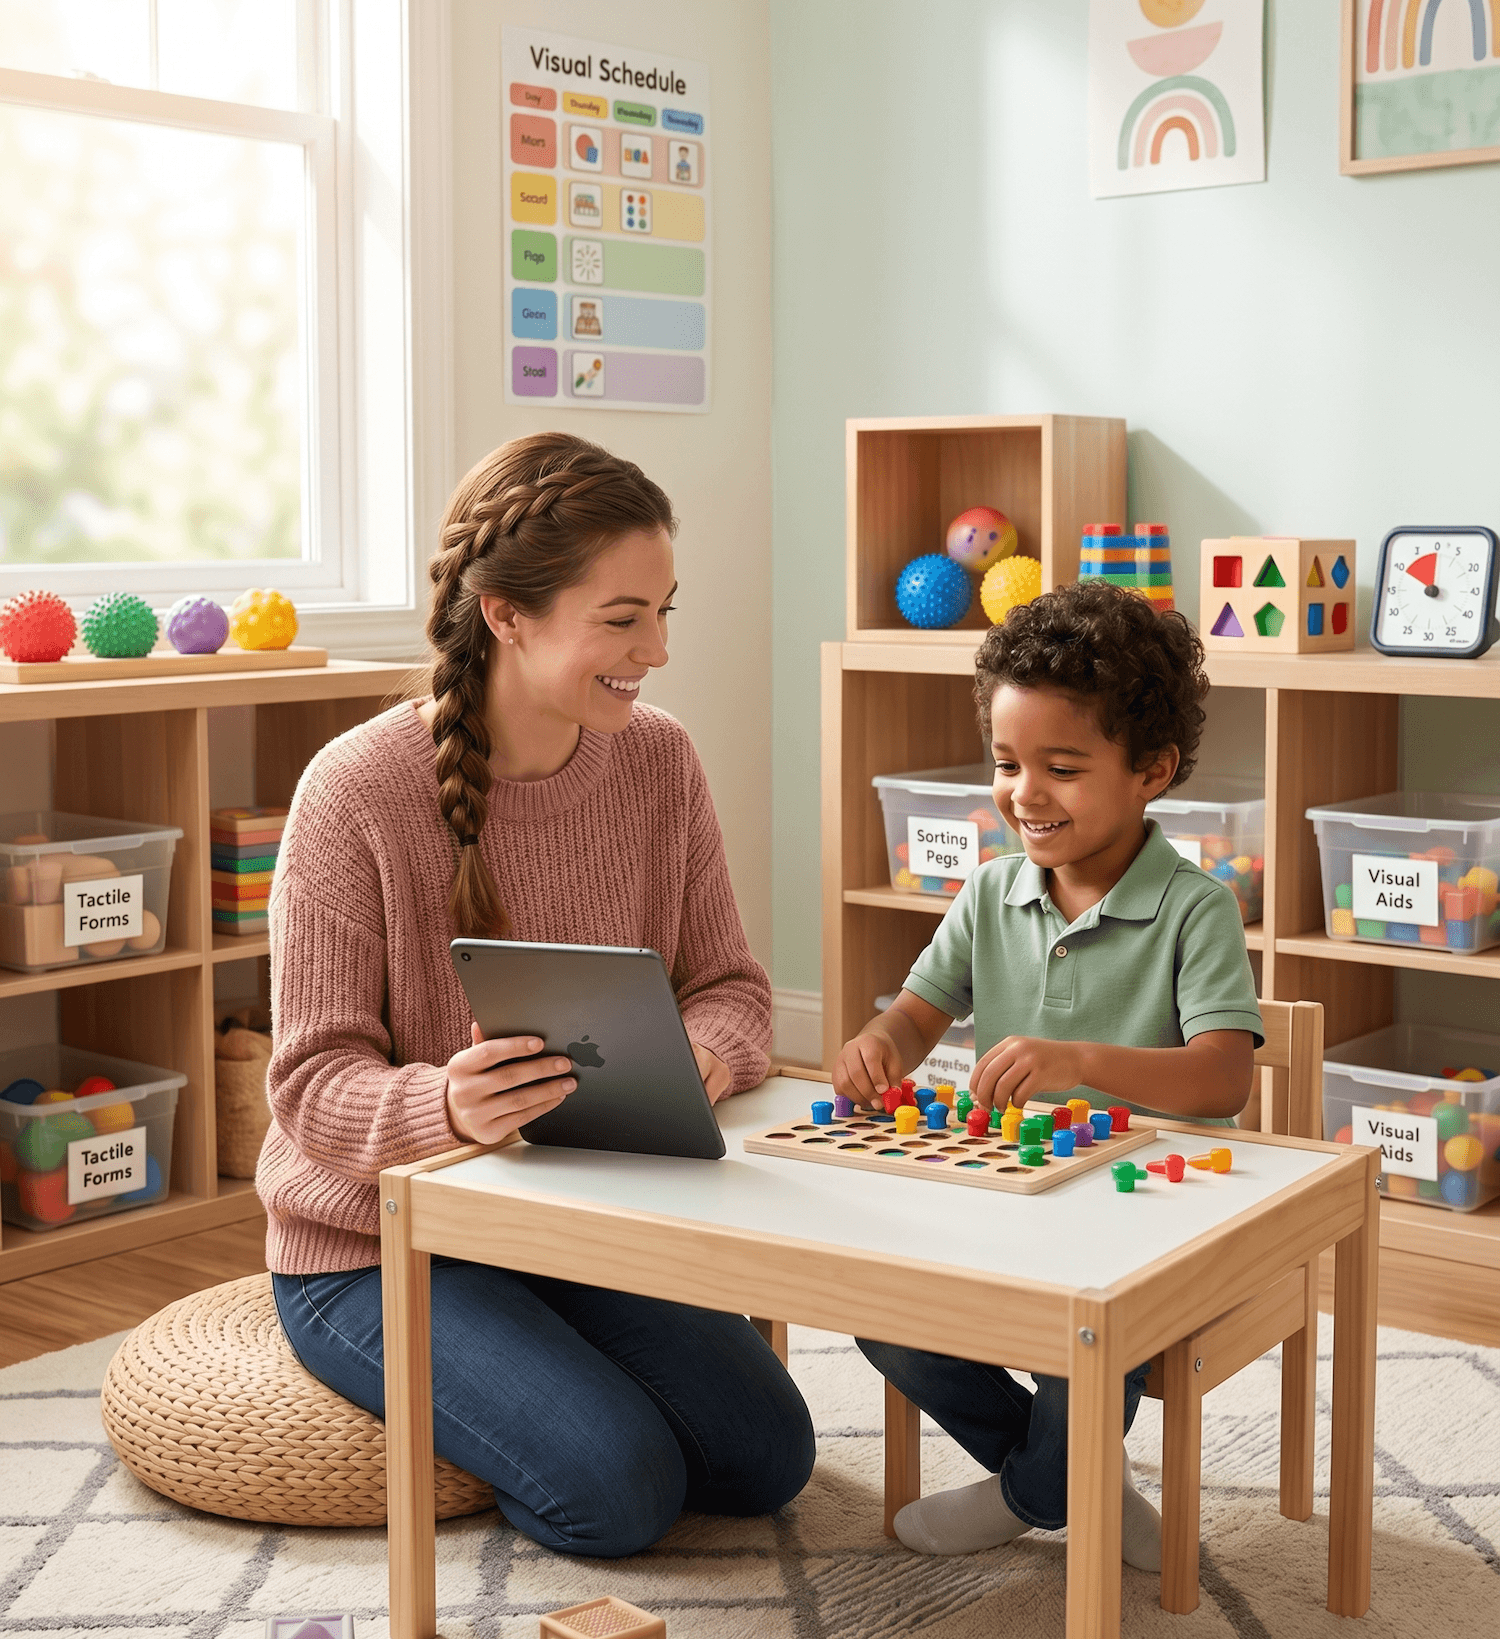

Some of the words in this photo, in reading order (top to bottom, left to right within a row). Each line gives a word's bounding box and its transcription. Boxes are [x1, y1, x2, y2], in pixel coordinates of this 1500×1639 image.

[530, 45, 592, 78] Visual
[599, 58, 686, 95] Schedule
[1434, 542, 1441, 551] 0
[1455, 547, 1461, 556] 5
[1468, 563, 1479, 572] 20
[1462, 610, 1473, 619] 40
[1403, 626, 1413, 635] 25
[1423, 632, 1434, 641] 30
[1445, 627, 1457, 636] 25
[917, 829, 967, 850] Sorting
[927, 850, 959, 868] Pegs
[1368, 868, 1420, 887] Visual
[77, 889, 131, 908] Tactile
[1376, 892, 1413, 909] Aids
[79, 914, 129, 931] Forms
[1368, 1120, 1419, 1142] Visual
[81, 1142, 134, 1166] Tactile
[84, 1167, 132, 1188] Forms
